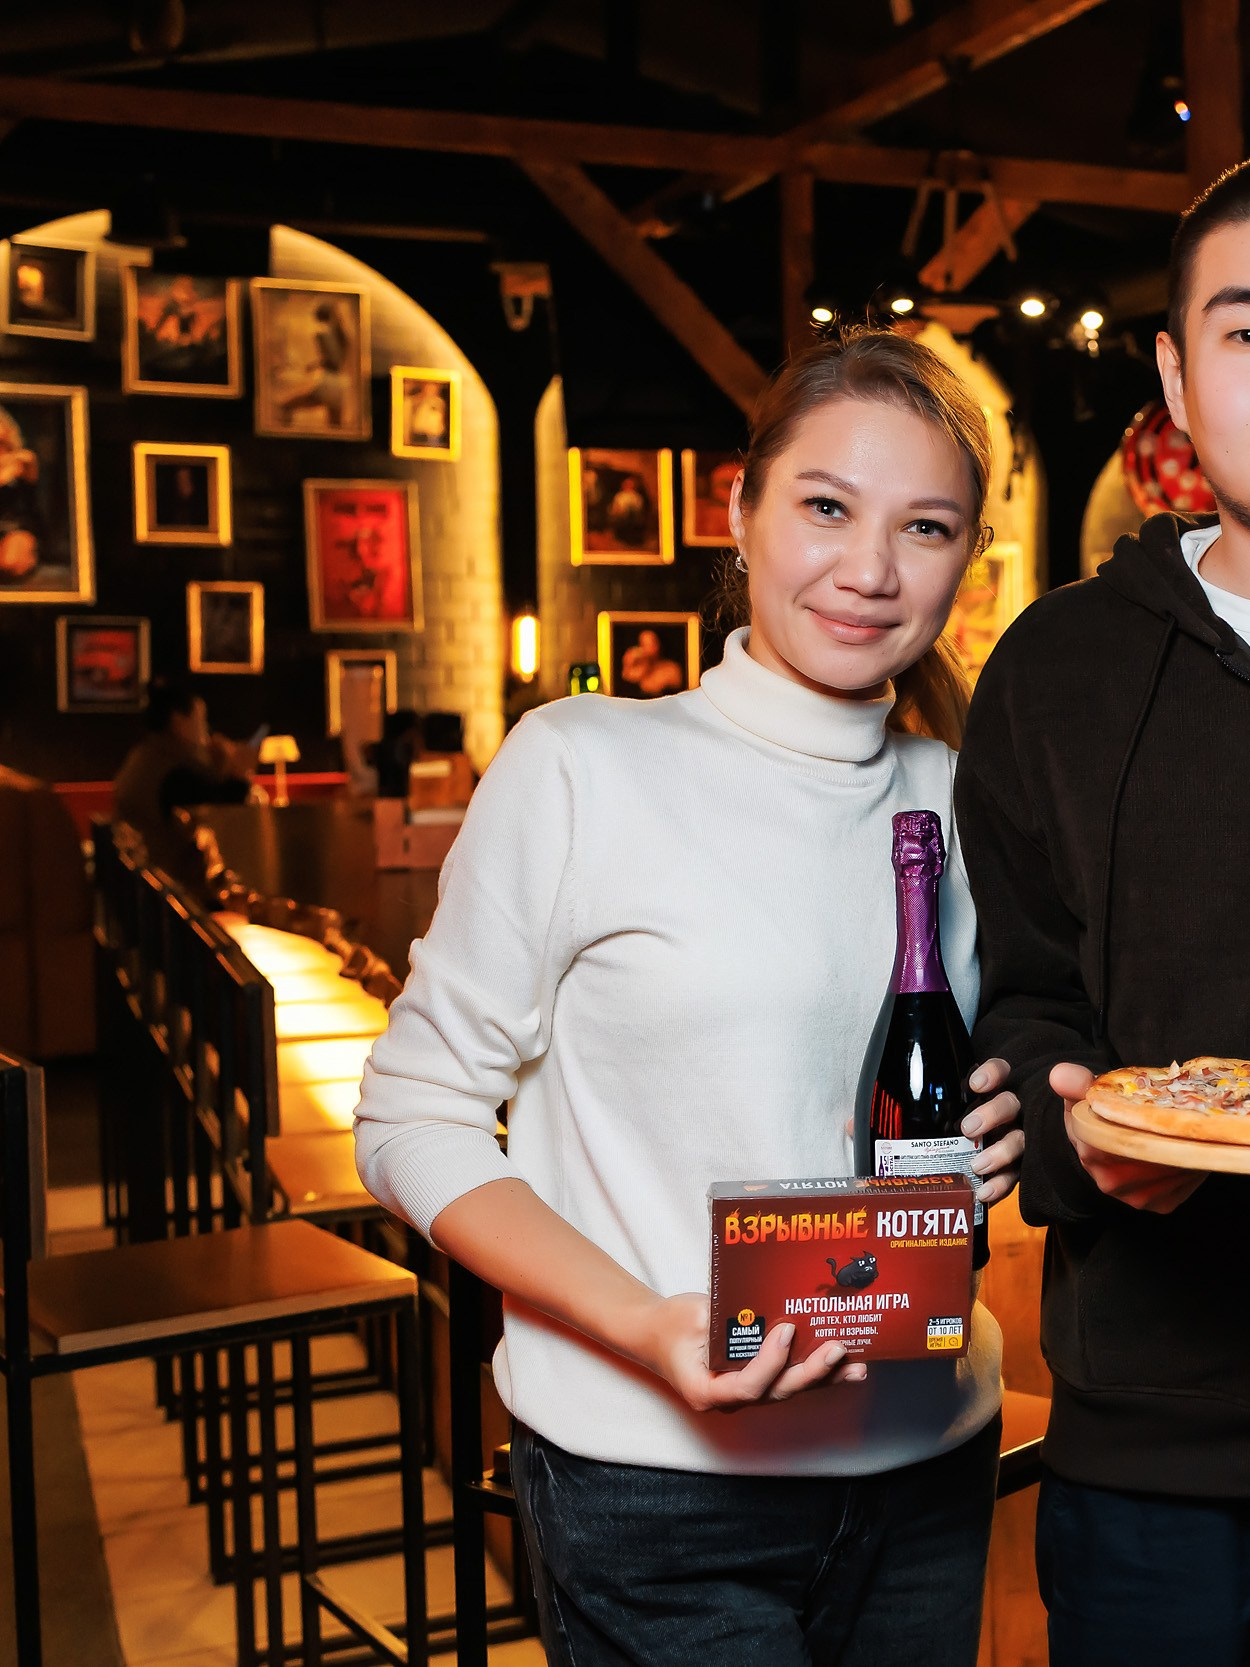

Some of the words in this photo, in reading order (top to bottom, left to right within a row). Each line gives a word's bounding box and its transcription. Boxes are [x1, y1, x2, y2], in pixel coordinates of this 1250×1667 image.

[933, 1139, 959, 1147] STEFANO
[724, 1206, 868, 1245] ВЗРЫВНЫЕ
[876, 1208, 969, 1238] КОТЯТА
[890, 1239, 938, 1248] ОРИГИНАЛЬНОЕ
[939, 1237, 968, 1247] ИЗДАНИЕ
[785, 1295, 873, 1314] НАСТОЛЬНАЯ
[876, 1293, 910, 1310] ИГРА
[810, 1316, 825, 1327] ДЛЯ
[843, 1315, 856, 1324] КТО
[857, 1313, 883, 1323] ЛЮБИТ
[732, 1324, 760, 1336] САМЫЙ
[840, 1328, 846, 1336] И
[929, 1327, 937, 1336] ОТ
[940, 1326, 948, 1335] 10
[949, 1325, 962, 1335] ЛЕТ
